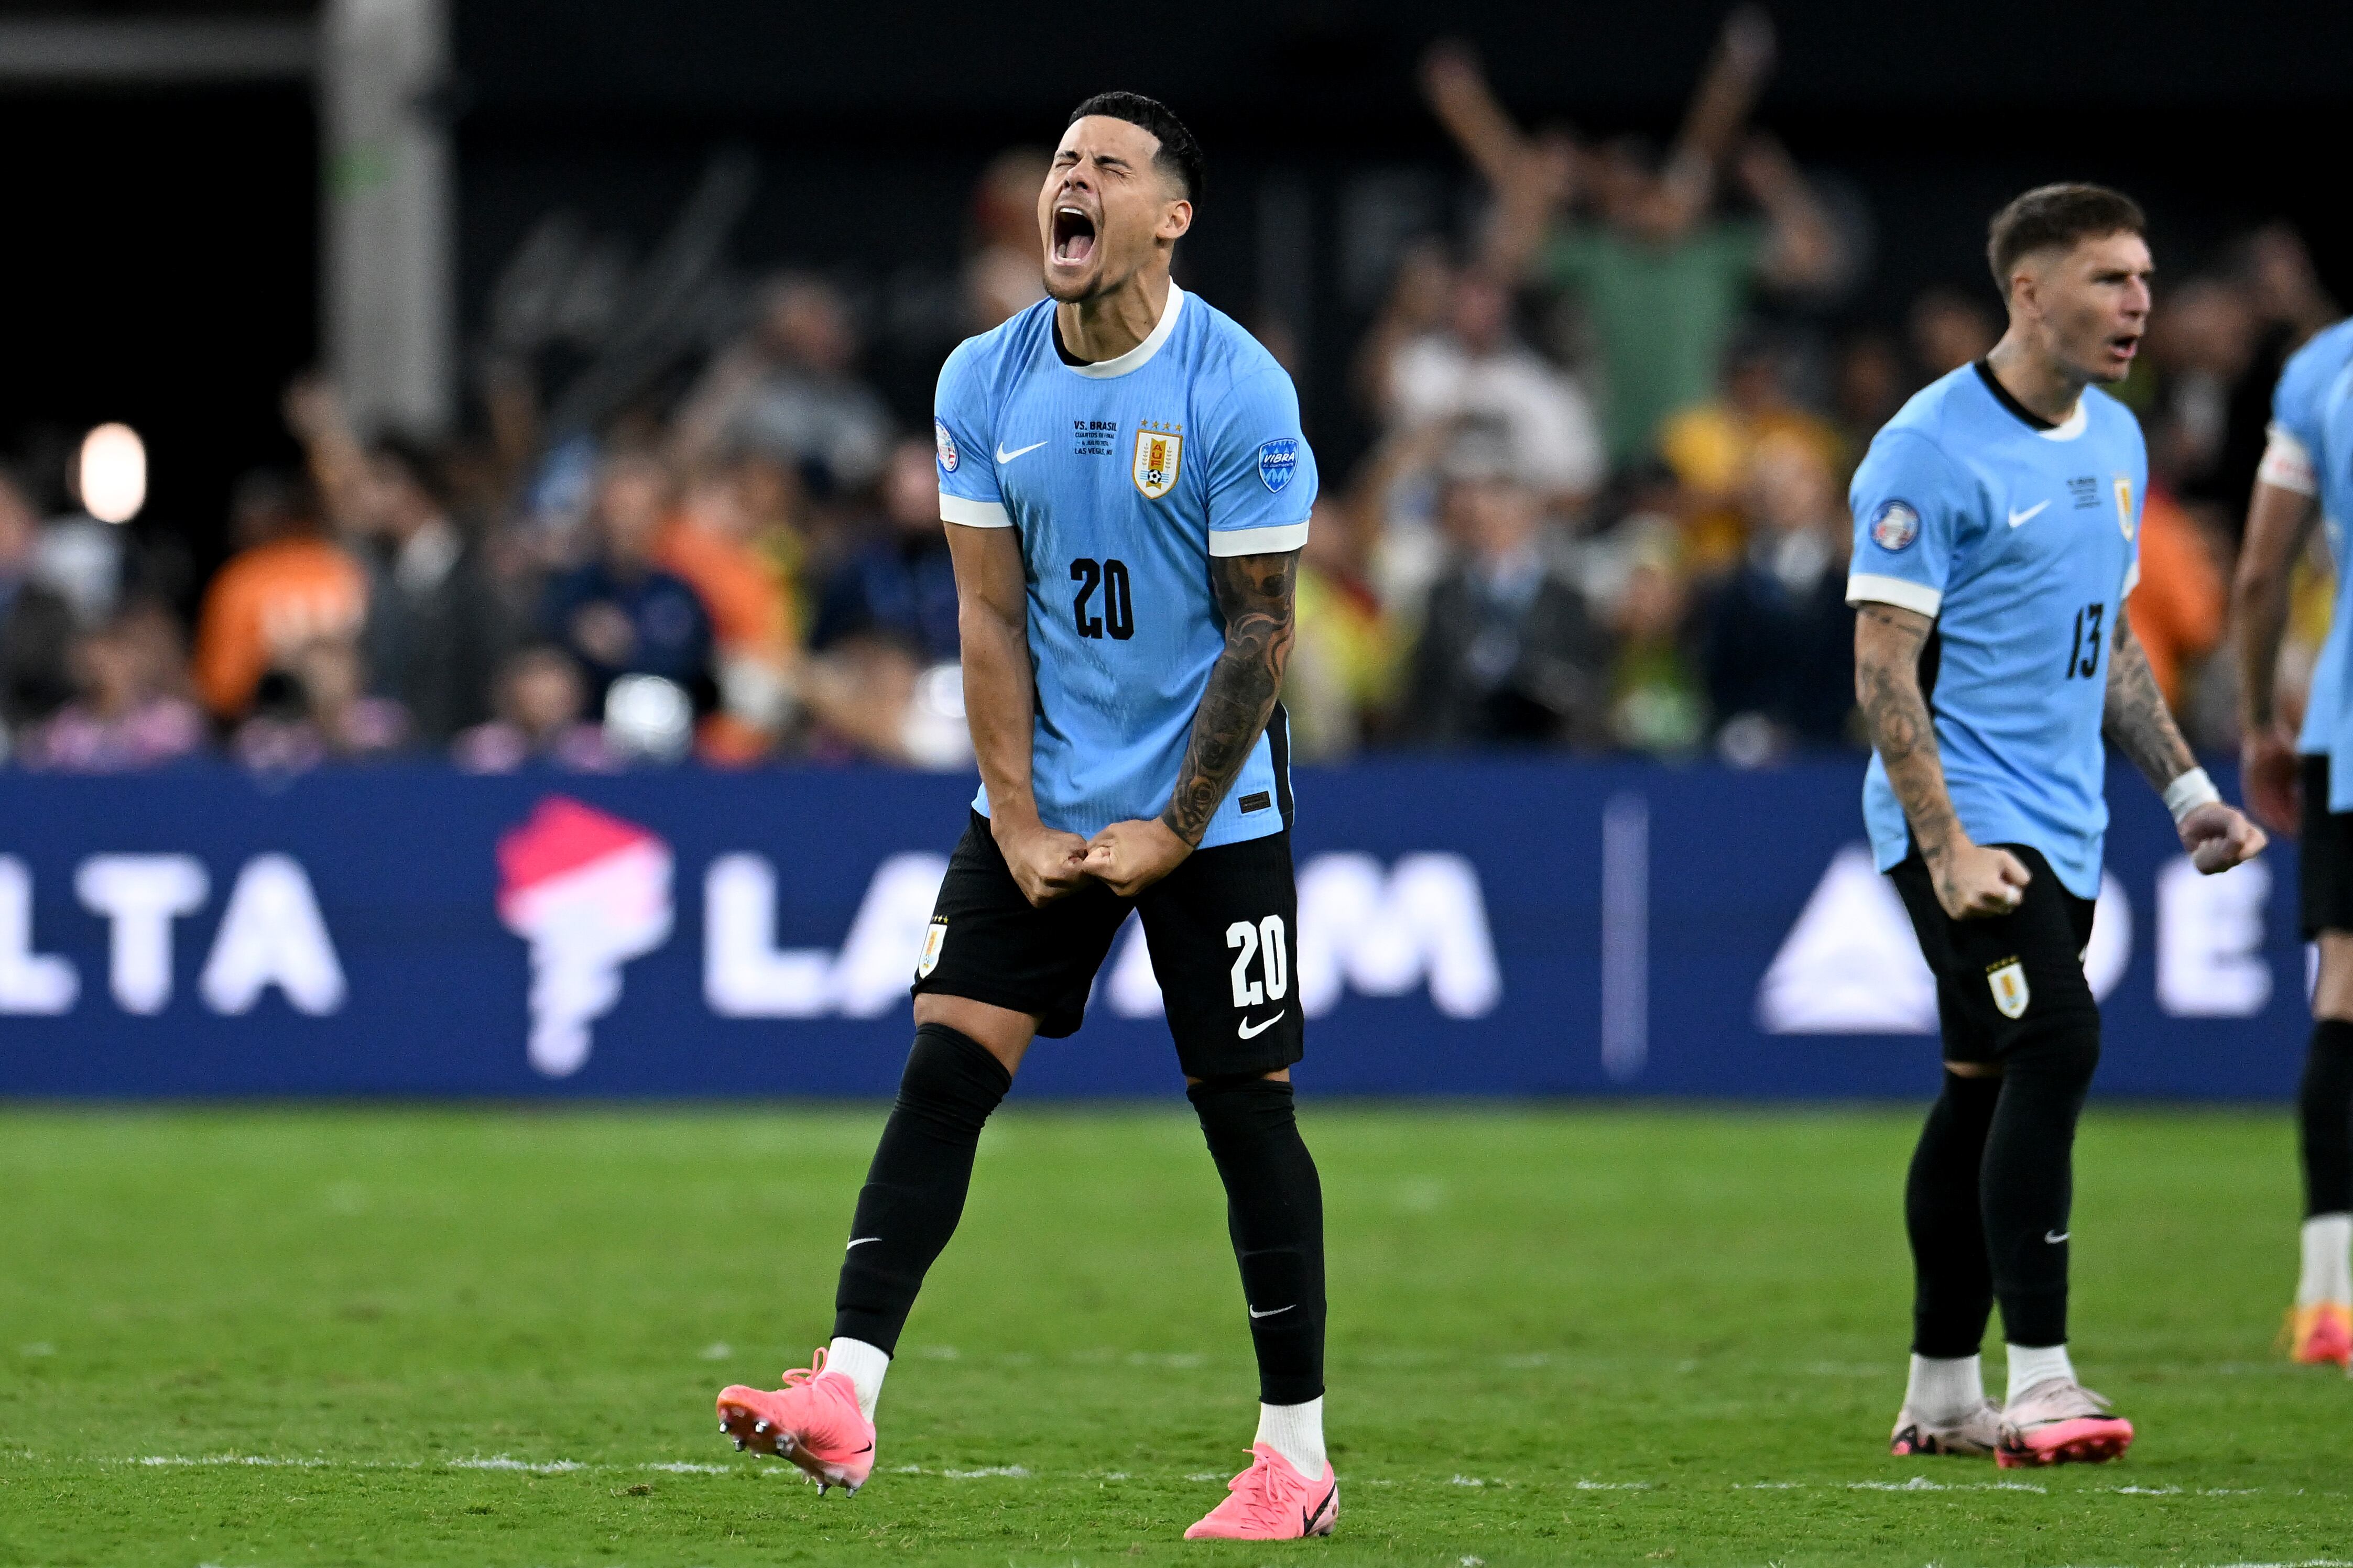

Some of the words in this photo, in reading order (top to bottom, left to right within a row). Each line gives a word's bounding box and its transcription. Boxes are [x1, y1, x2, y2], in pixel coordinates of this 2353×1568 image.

[1074, 421, 1087, 431] VS.
[1090, 421, 1117, 431] BRASIL
[1264, 452, 1295, 463] VIBRA
[1070, 558, 1135, 640] 20
[2066, 603, 2104, 678] 13
[1226, 914, 1287, 1007] 20
